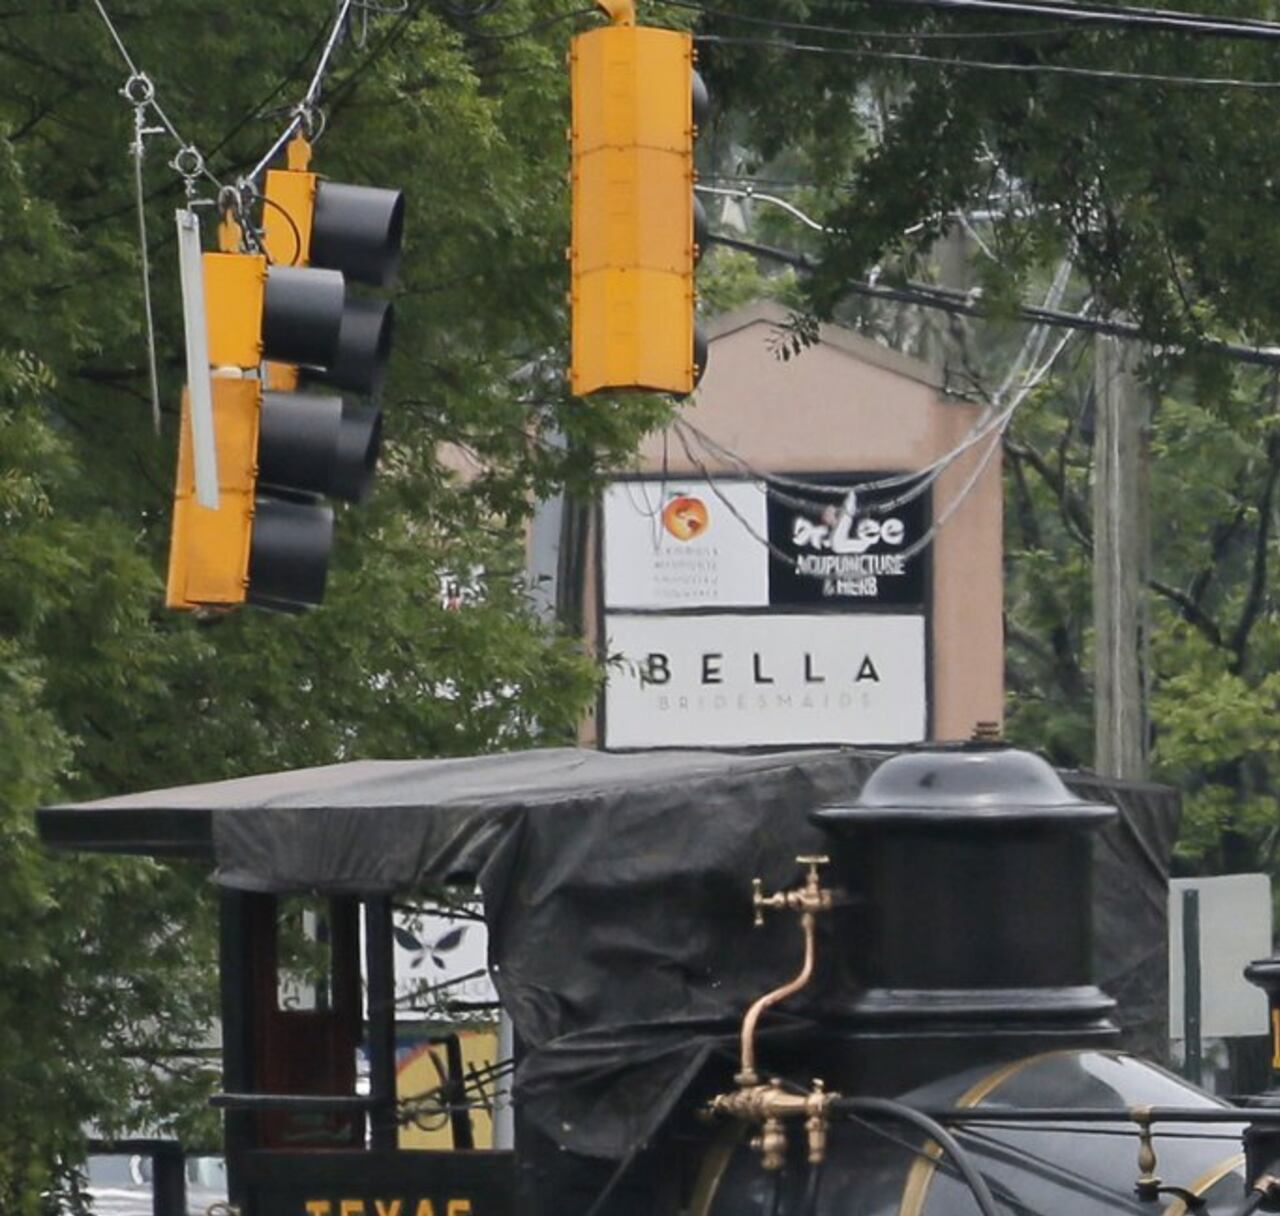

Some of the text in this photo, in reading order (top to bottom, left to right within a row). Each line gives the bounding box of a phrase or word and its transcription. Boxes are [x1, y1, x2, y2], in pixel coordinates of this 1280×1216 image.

[832, 490, 904, 553] Lee
[795, 554, 905, 575] ACUPUNCTURE
[837, 576, 878, 596] HERB
[648, 652, 881, 685] BELLA
